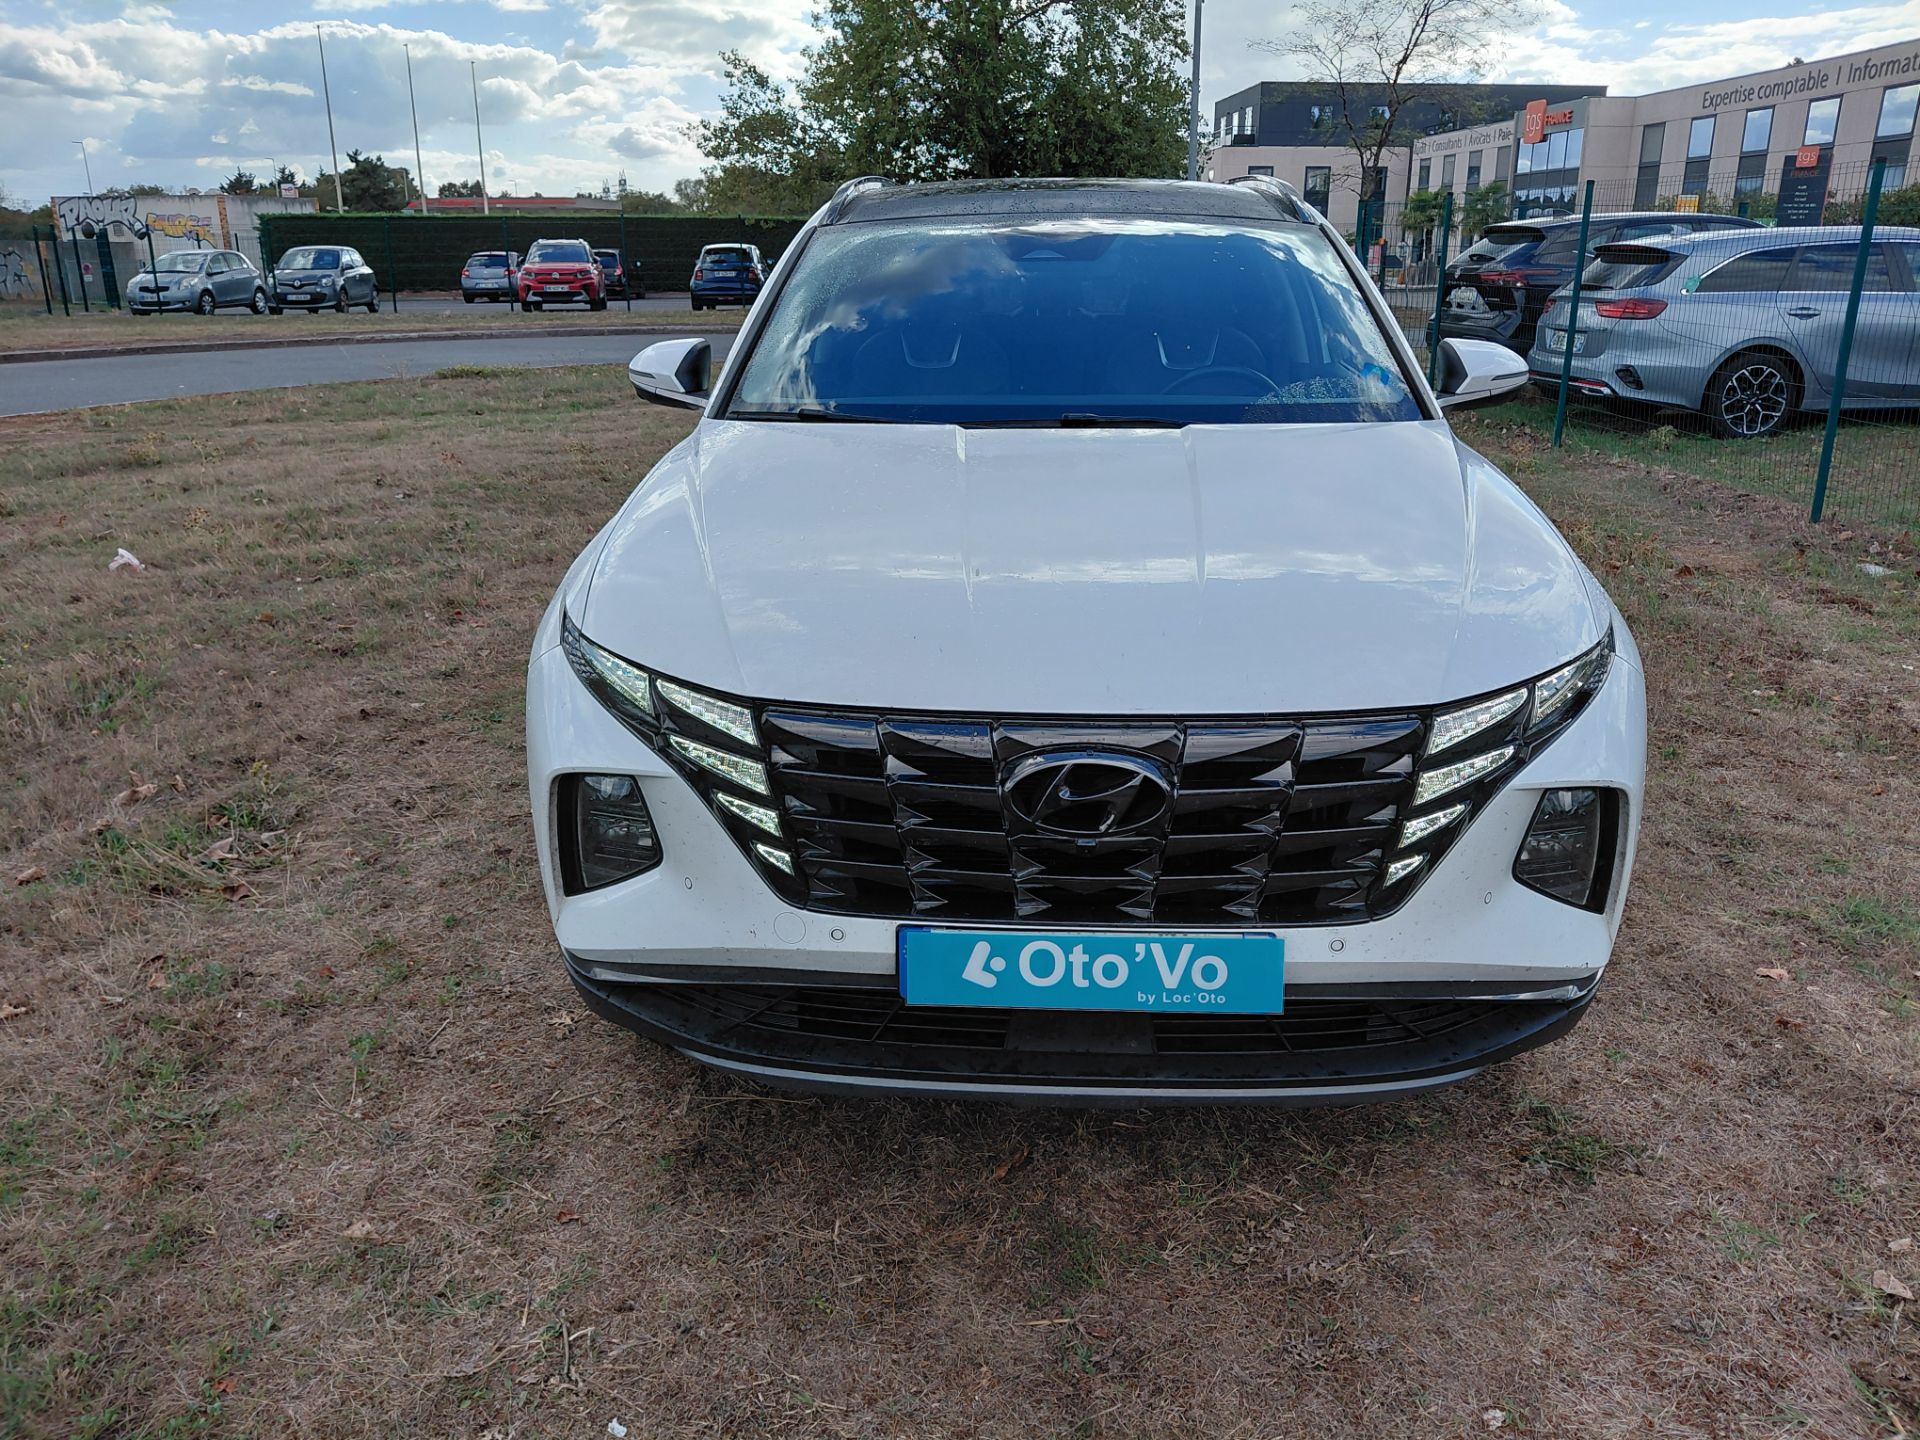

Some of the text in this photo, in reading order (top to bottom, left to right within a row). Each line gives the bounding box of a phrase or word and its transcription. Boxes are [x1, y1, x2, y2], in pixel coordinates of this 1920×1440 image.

[1702, 85, 1755, 111] Expertise
[1757, 69, 1829, 100] comptable
[1847, 52, 1920, 83] Informat
[1526, 112, 1542, 137] tgs
[1469, 131, 1491, 147] Avocats
[1799, 151, 1817, 164] tgs
[1137, 991, 1155, 1005] by
